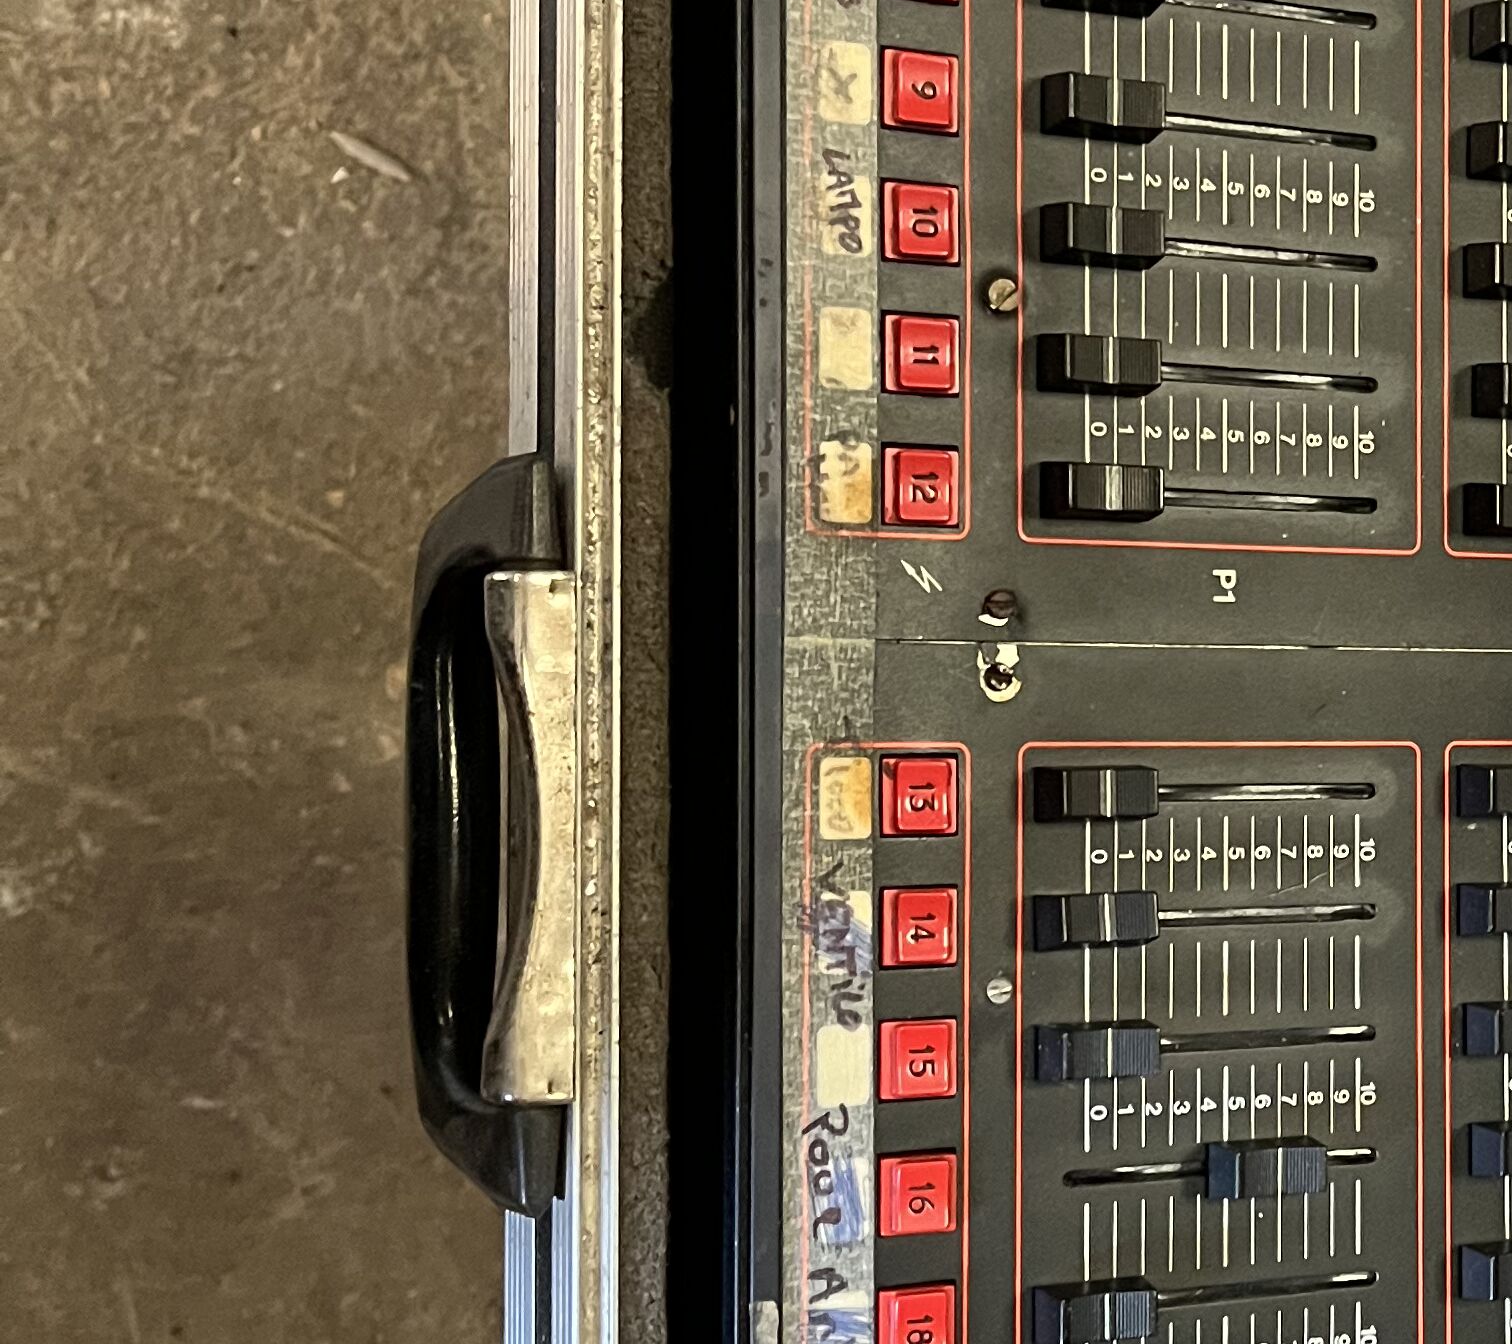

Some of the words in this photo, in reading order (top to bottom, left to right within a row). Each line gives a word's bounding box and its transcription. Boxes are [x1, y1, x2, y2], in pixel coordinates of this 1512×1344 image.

[911, 80, 938, 101] 9
[911, 205, 939, 239] 10
[912, 344, 940, 366] 11
[911, 471, 940, 504] 12
[1213, 569, 1239, 605] P1
[908, 782, 936, 813] 13
[909, 912, 937, 943] 14
[908, 1044, 936, 1078] 15
[1227, 1095, 1246, 1111] 5
[1253, 1093, 1272, 1108] 6
[1280, 1092, 1298, 1107] 7
[1307, 1090, 1324, 1106] 8
[1333, 1088, 1351, 1105] 9
[1359, 1081, 1377, 1106] 10
[1089, 1104, 1108, 1122] 0
[1144, 1101, 1164, 1117] 2
[1172, 1099, 1192, 1116] 3
[1199, 1096, 1218, 1113] 4
[908, 1182, 936, 1215] 16
